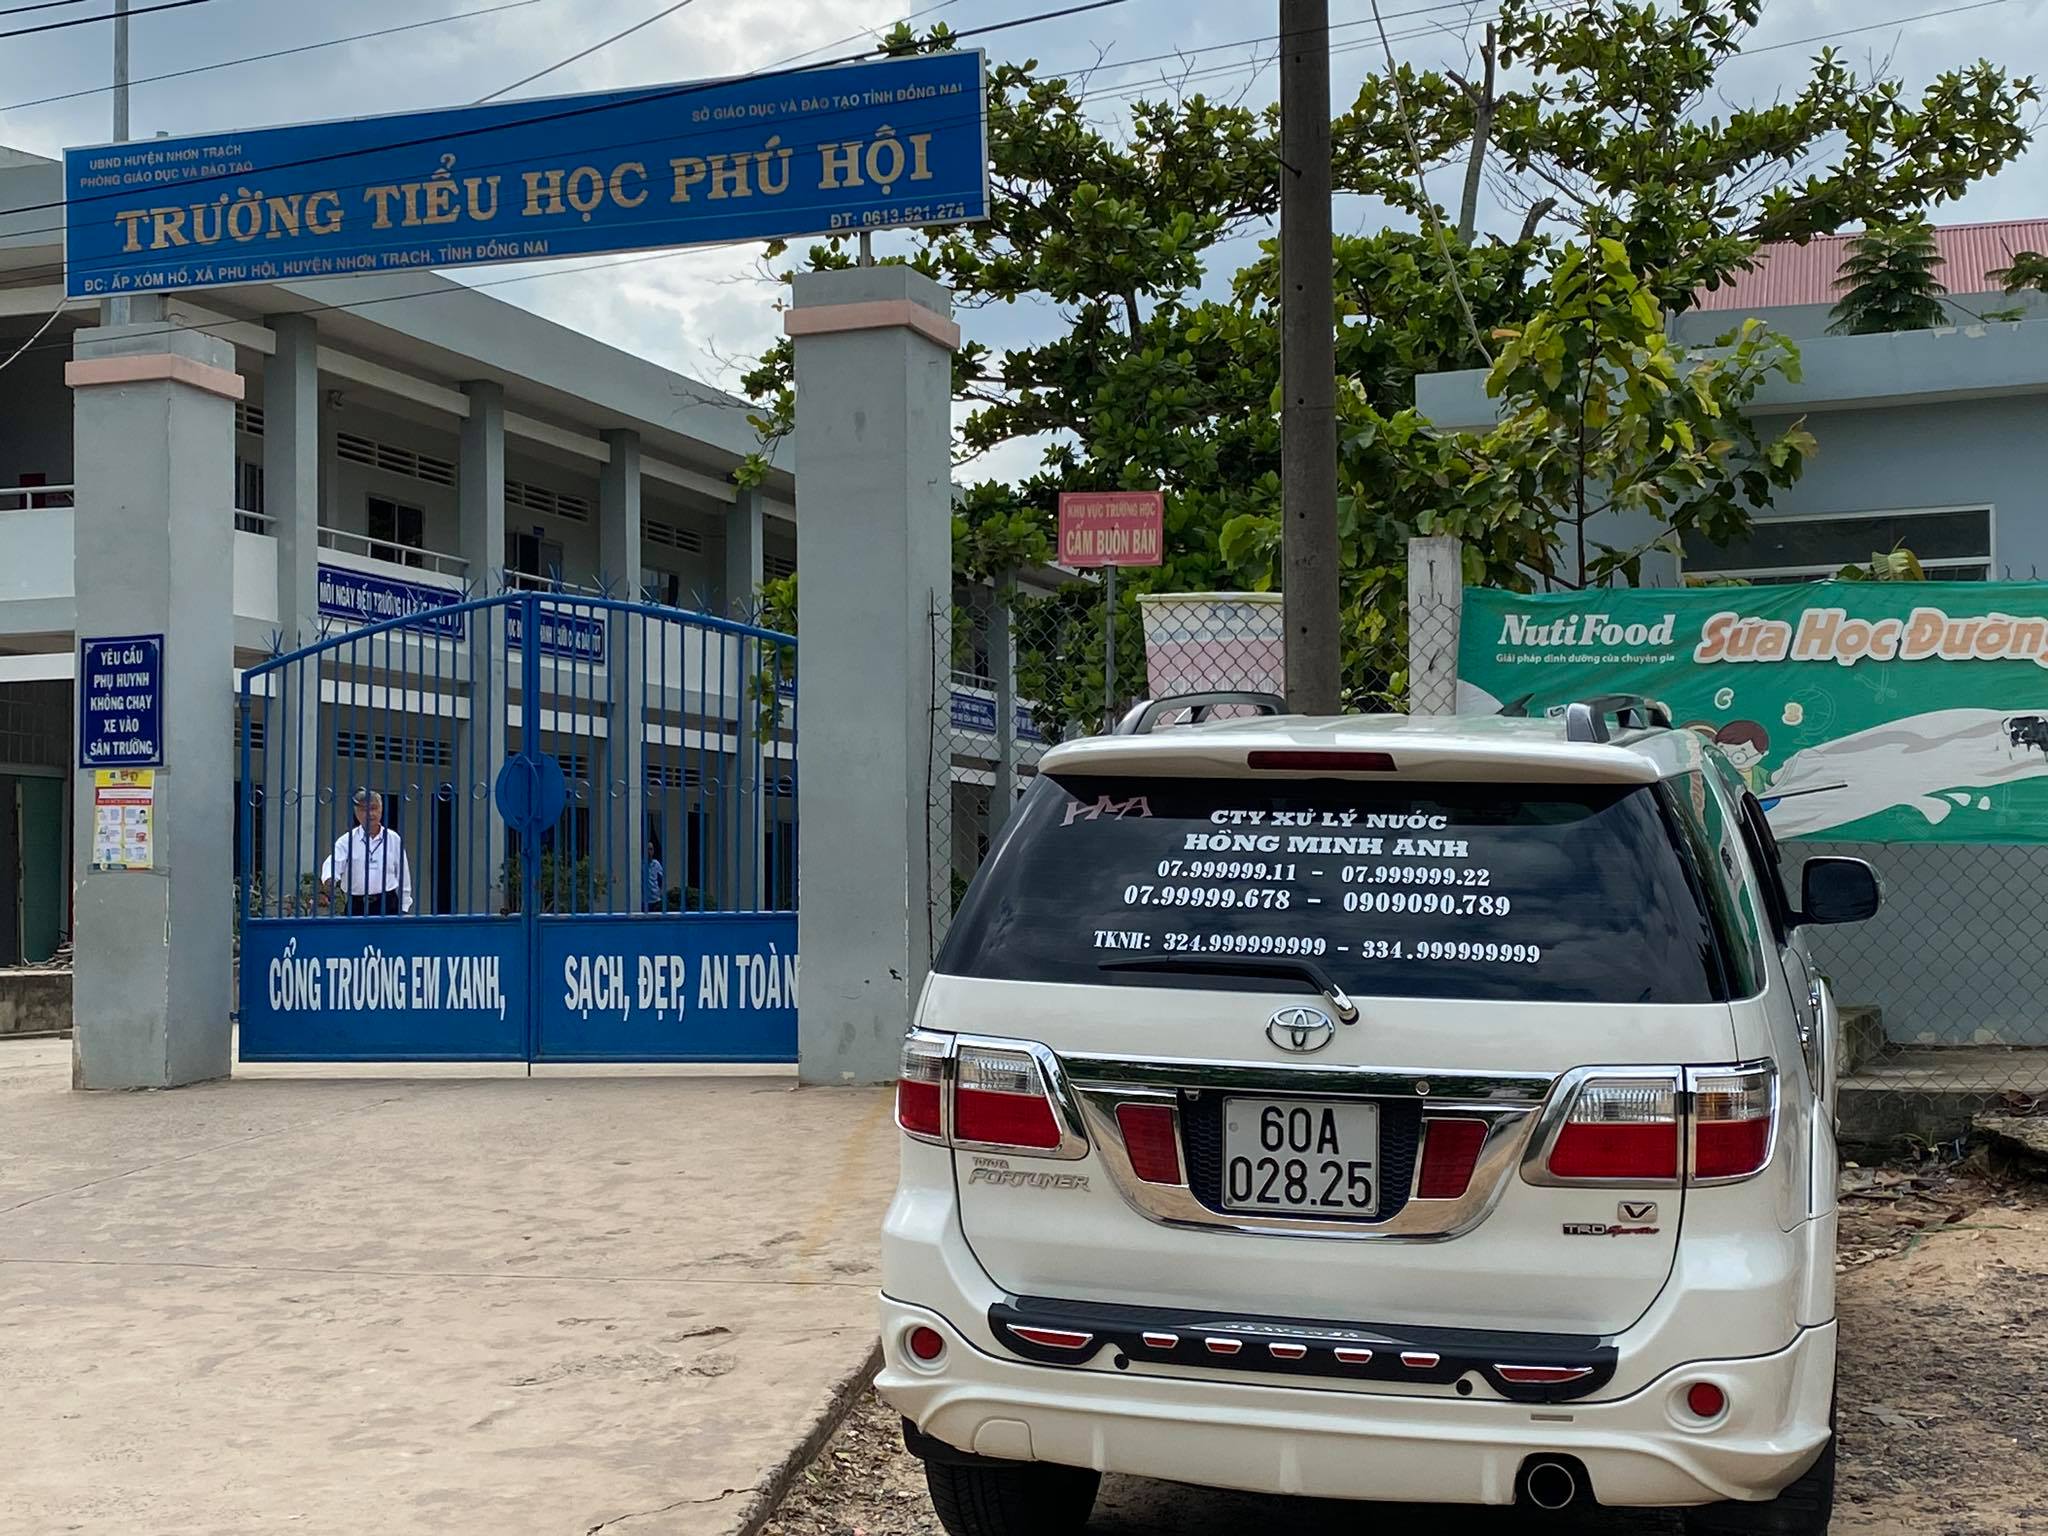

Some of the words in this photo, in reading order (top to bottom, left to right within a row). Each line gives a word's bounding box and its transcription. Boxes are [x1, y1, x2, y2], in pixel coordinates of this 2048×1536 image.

[714, 105, 745, 120] GIÁO
[749, 103, 775, 117] DỤC
[780, 98, 797, 113] VÀ
[801, 96, 830, 111] ĐÀO
[832, 94, 860, 109] TẠO
[862, 88, 893, 105] TỈNH
[89, 157, 121, 171] UBND
[124, 151, 164, 168] HUYỆN
[166, 148, 200, 163] NHƠN
[202, 144, 242, 159] TRẠCH
[80, 174, 121, 188] PHÒNG
[124, 170, 152, 185] GIÁO
[154, 168, 179, 183] DỤC
[182, 163, 197, 178] VÀ
[114, 187, 345, 252] TRƯỜNG
[363, 153, 501, 229] TIỂU
[521, 161, 648, 222] HỌC
[669, 135, 794, 203] PHÚ
[818, 123, 933, 195] HỘI
[830, 212, 857, 228] ĐT:
[862, 202, 965, 225] 0613.521.274
[84, 278, 108, 292] ĐC:
[112, 271, 130, 289] ẤP
[283, 256, 332, 275] HUYỆN
[336, 254, 377, 270] NHƠN
[438, 242, 472, 260] TỈNH
[476, 239, 519, 258] ĐỒNG
[523, 239, 549, 254] NAI
[1066, 520, 1093, 556] CẤM
[1096, 522, 1129, 555] BUÔN
[1132, 521, 1156, 554] BÁN
[1497, 614, 1677, 646] NutiFood
[1696, 613, 1789, 661] Sữa
[1793, 610, 1901, 664] Học
[1901, 609, 2048, 666] Đườn
[101, 648, 121, 666] YÊU
[122, 644, 143, 665] CẦU
[1517, 653, 1542, 664] pháp
[1602, 653, 1620, 663] của
[1621, 653, 1658, 664] chuyên
[1659, 653, 1675, 664] gia
[93, 674, 114, 691] PHỤ
[116, 672, 150, 688] HUYNH
[90, 693, 124, 711] KHÔNG
[126, 694, 153, 712] CHẠY
[104, 719, 117, 733] XE
[119, 715, 139, 733] VÀO
[90, 738, 111, 756] SÂN
[112, 737, 153, 756] TRƯỜNG
[1210, 809, 1266, 826] CTY
[1270, 808, 1316, 826] XỬ
[1321, 808, 1358, 828] LÝ
[1366, 810, 1447, 831] NƯỚC
[1183, 829, 1281, 853] HỒNG
[1287, 835, 1384, 856] MINH
[1392, 839, 1469, 857] ANH
[1157, 860, 1296, 881] 07.999999.11
[1341, 866, 1490, 887] 07.999999.22
[1123, 885, 1291, 910] 07.99999.678
[1343, 892, 1511, 916] 0909090.789
[1163, 933, 1327, 956] 324.999999999
[1362, 940, 1540, 963] 334.999999999
[269, 936, 321, 1011] CỔNG
[326, 945, 406, 1011] TRƯỜNG
[411, 956, 441, 1010] EM
[446, 956, 506, 1021] XANH,
[564, 954, 630, 1022] SẠCH,
[637, 954, 686, 1022] ĐẸP,
[698, 954, 729, 1010] AN
[735, 942, 799, 1010] TOÀN
[1260, 1105, 1340, 1155] 60A
[968, 1167, 1092, 1193] FORTUNER
[1229, 1156, 1372, 1208] 028.25
[1623, 1204, 1654, 1219] V
[1563, 1224, 1606, 1235] TRD
